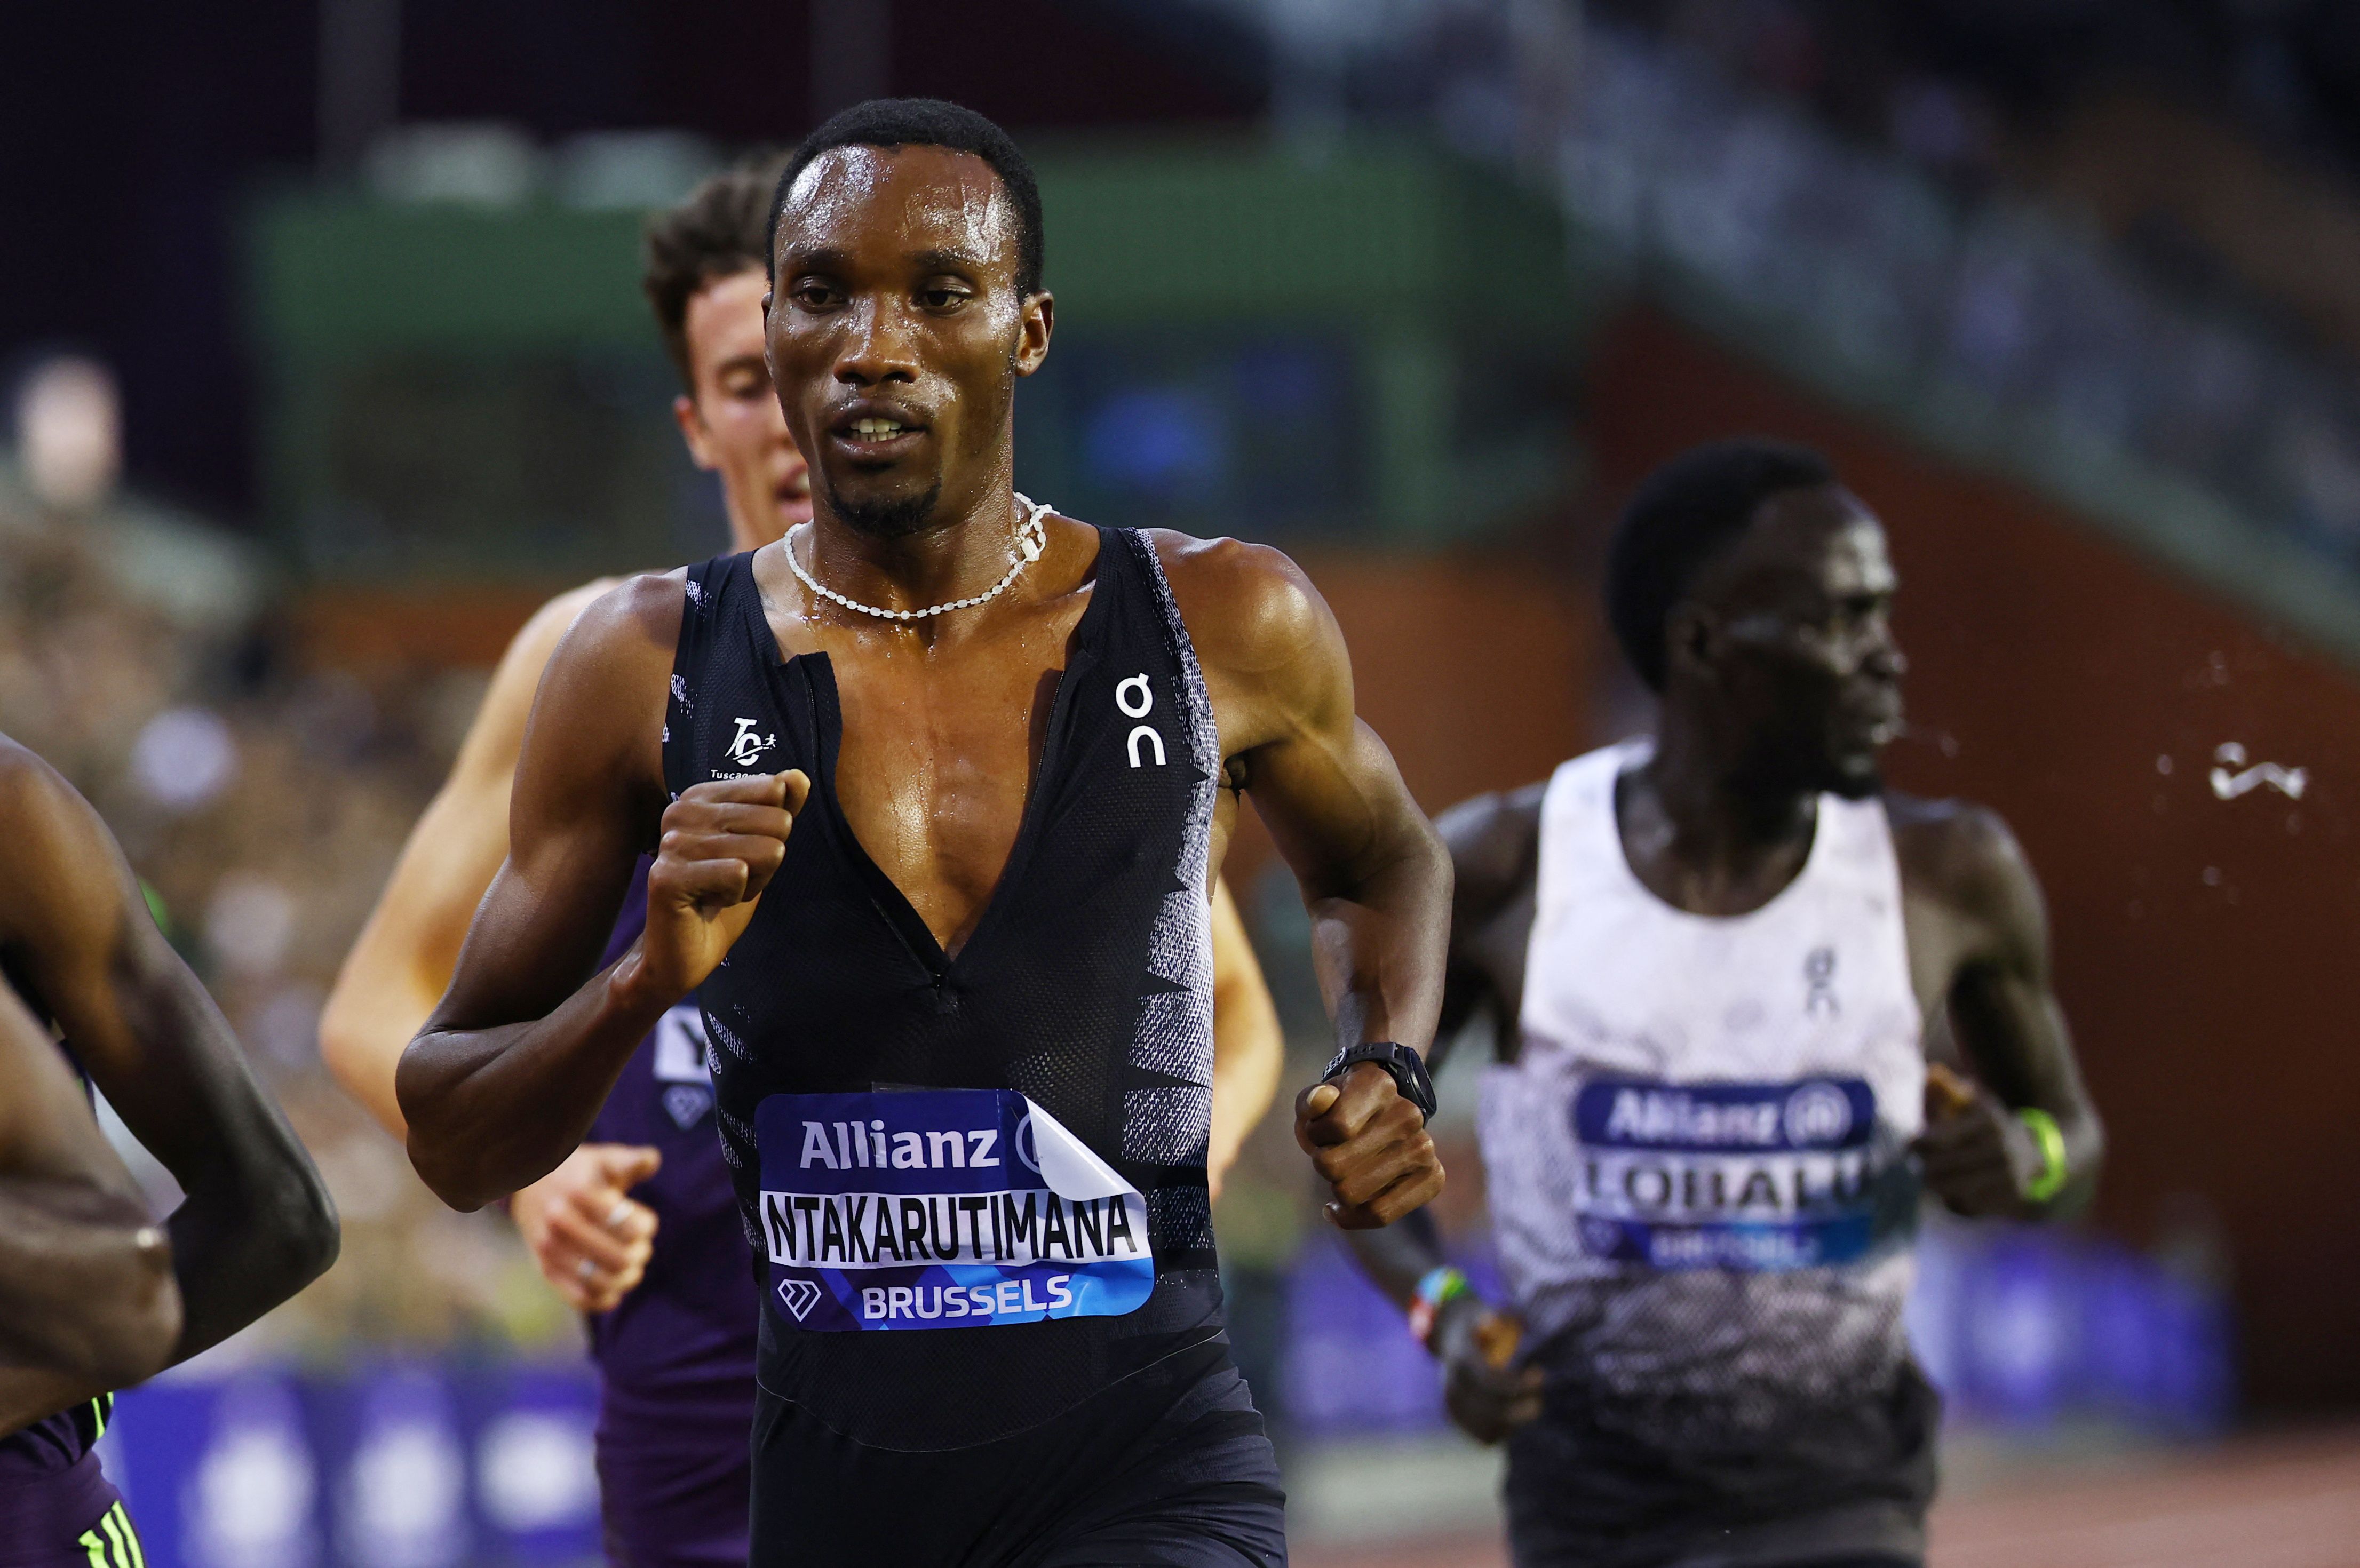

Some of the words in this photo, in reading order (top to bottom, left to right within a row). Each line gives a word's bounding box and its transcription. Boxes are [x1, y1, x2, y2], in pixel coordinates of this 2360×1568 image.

[710, 769, 756, 779] Tuscan
[799, 1119, 1000, 1170] Allianz
[766, 1193, 1137, 1261] NTAKARUTIMANA
[862, 1274, 1073, 1320] BRUSSELS
